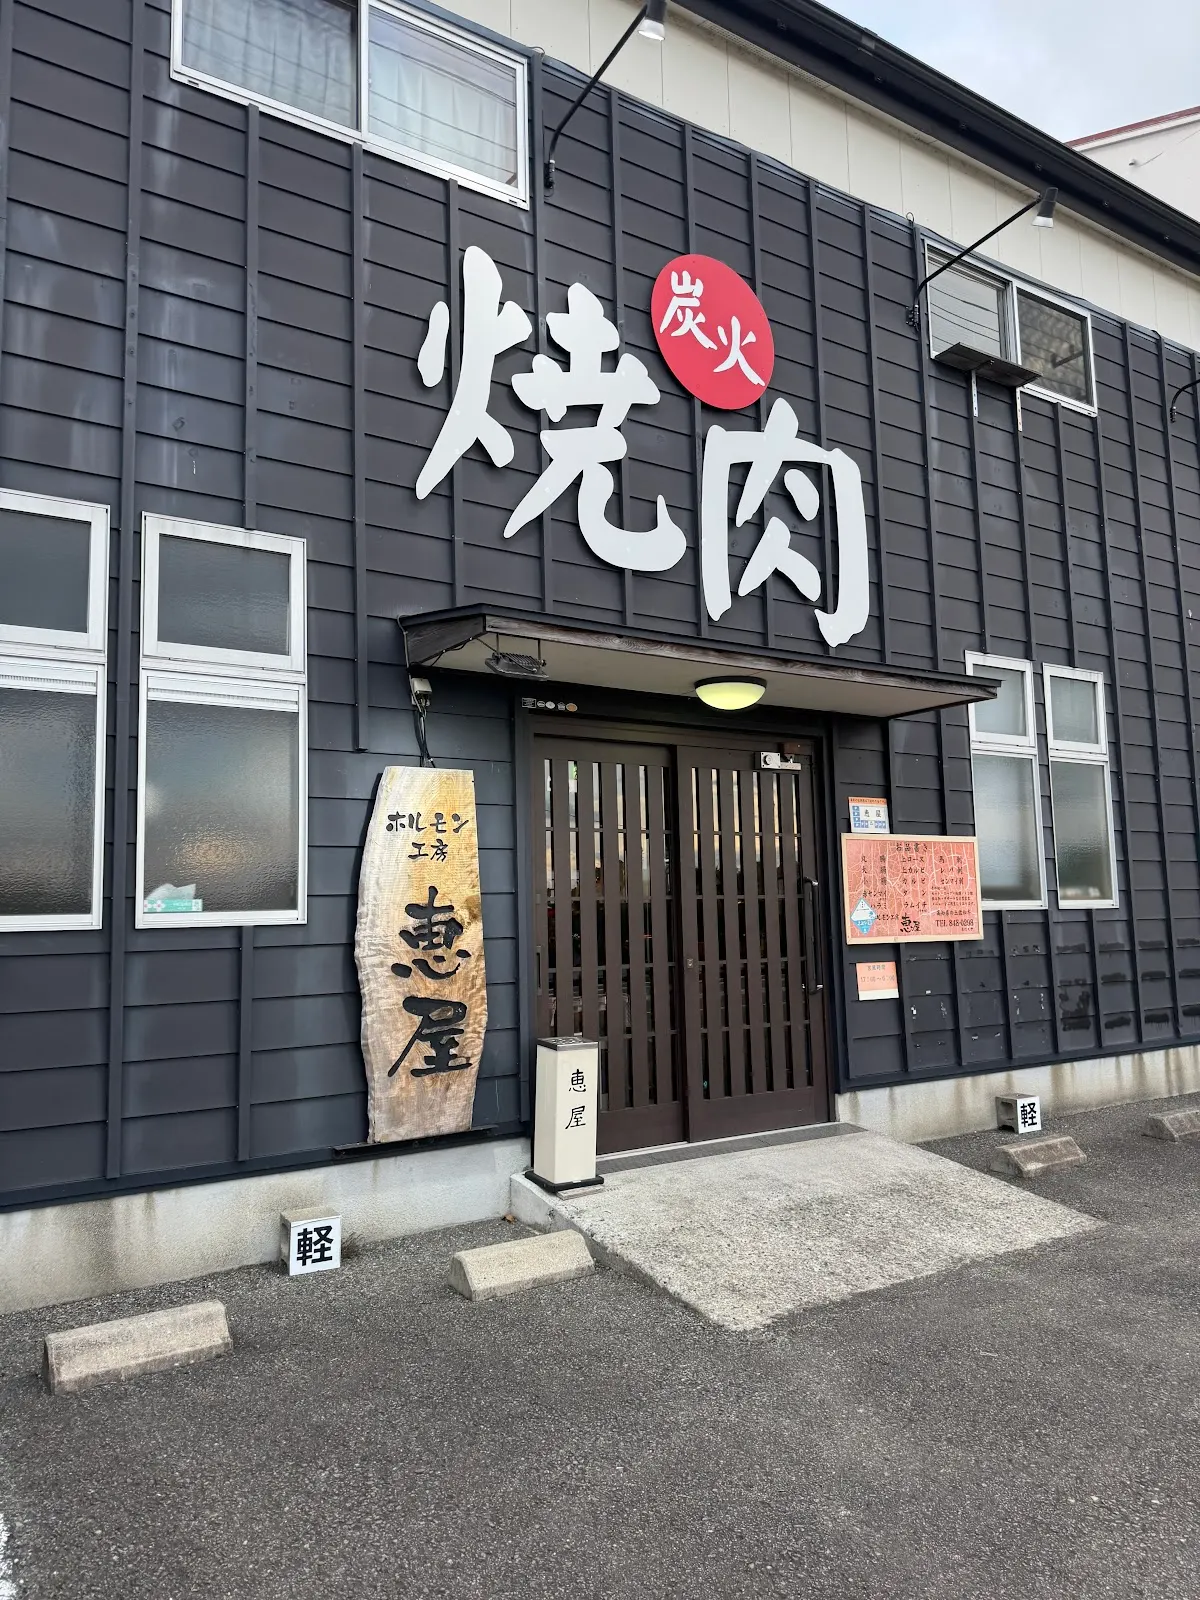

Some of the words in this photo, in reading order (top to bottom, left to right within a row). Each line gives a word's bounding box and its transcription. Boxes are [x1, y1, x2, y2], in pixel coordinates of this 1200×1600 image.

[660, 270, 766, 386] 炭火
[415, 245, 870, 647] 焼肉
[386, 811, 471, 834] ホルモン
[407, 838, 448, 861] 工房
[896, 842, 928, 852] お品書き
[901, 855, 925, 863] 上ロース
[901, 866, 925, 874] 上カルビ
[902, 877, 926, 885] カルビ
[900, 912, 921, 933] 恵屋
[388, 886, 473, 1079] 恵屋
[565, 1069, 588, 1130] 恵屋
[1020, 1102, 1038, 1128] 軽
[296, 1225, 334, 1267] 軽
